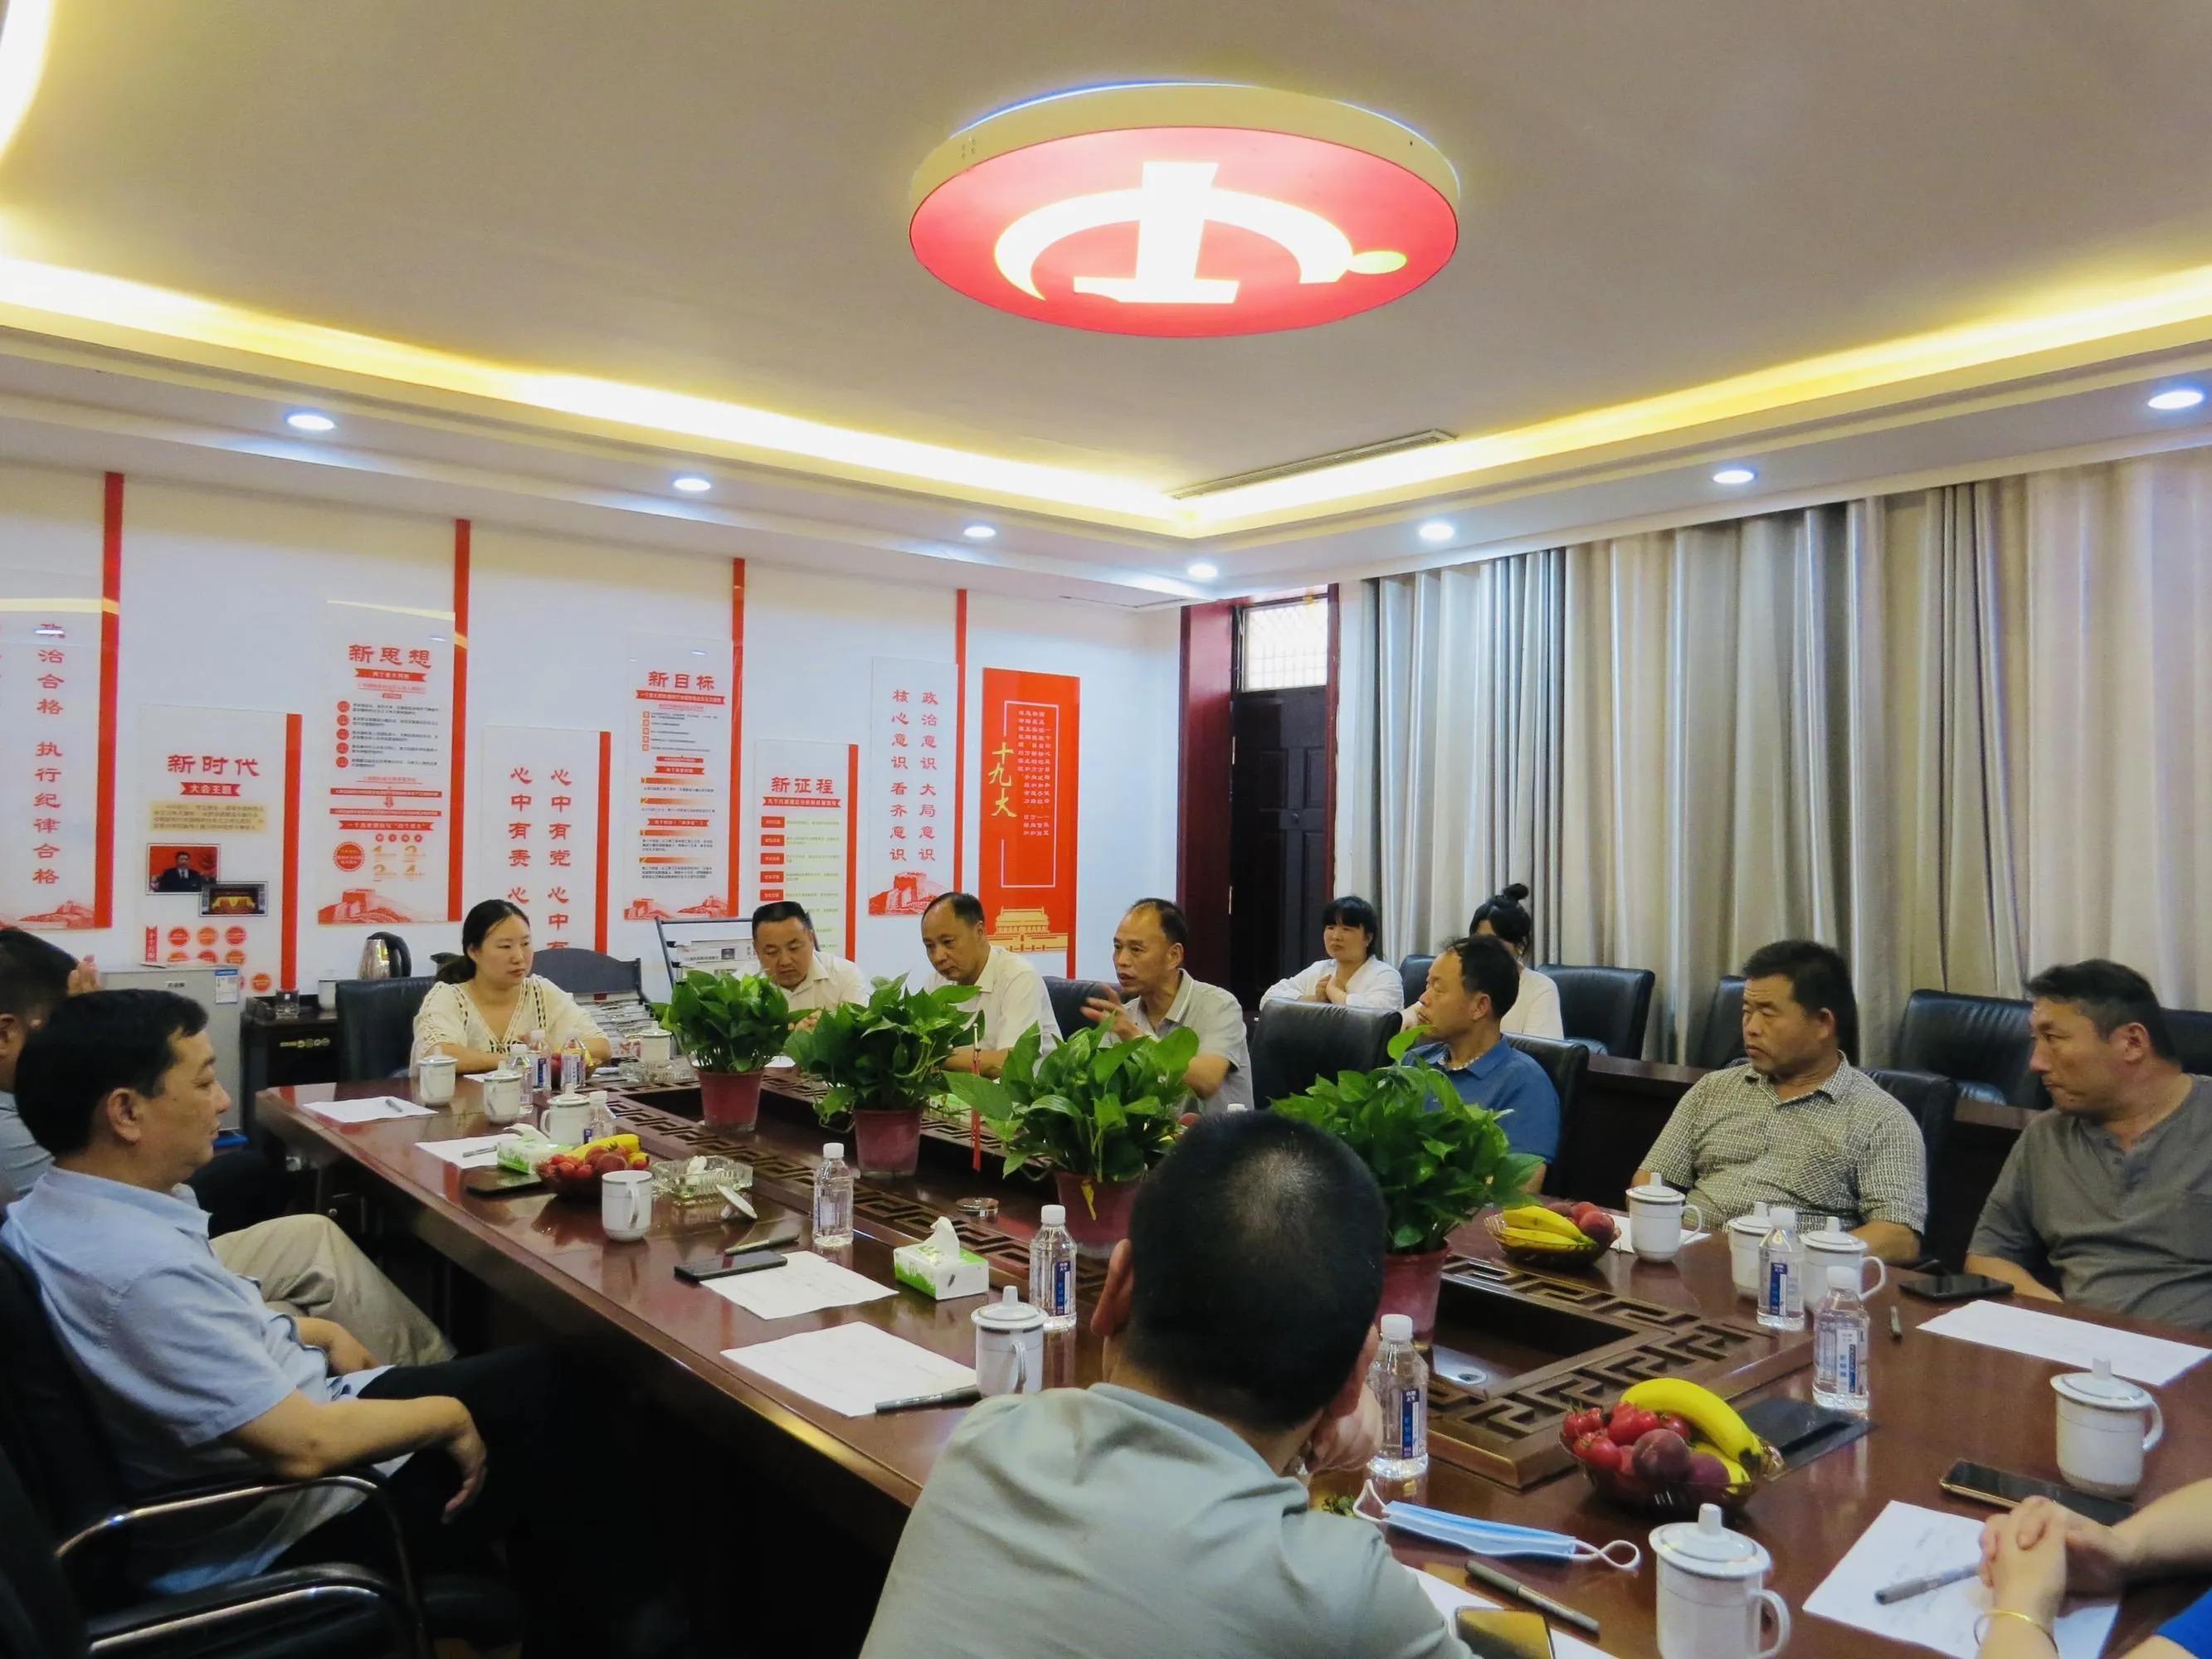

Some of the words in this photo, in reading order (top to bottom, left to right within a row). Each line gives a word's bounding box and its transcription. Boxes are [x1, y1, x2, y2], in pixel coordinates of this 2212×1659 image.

[348, 645, 431, 669] 新思想
[648, 671, 714, 690] 新目标
[168, 755, 260, 776] 新时代
[891, 689, 909, 770] 核心意识
[920, 691, 938, 770] 政治意识
[32, 742, 64, 885] 执行纪律合格
[508, 767, 533, 867] 心中有责
[547, 768, 572, 867] 心中有党
[771, 776, 834, 794] 新征程
[988, 741, 1017, 818] 十九大
[889, 782, 908, 862] 看齐意识
[918, 783, 937, 862] 大局意识
